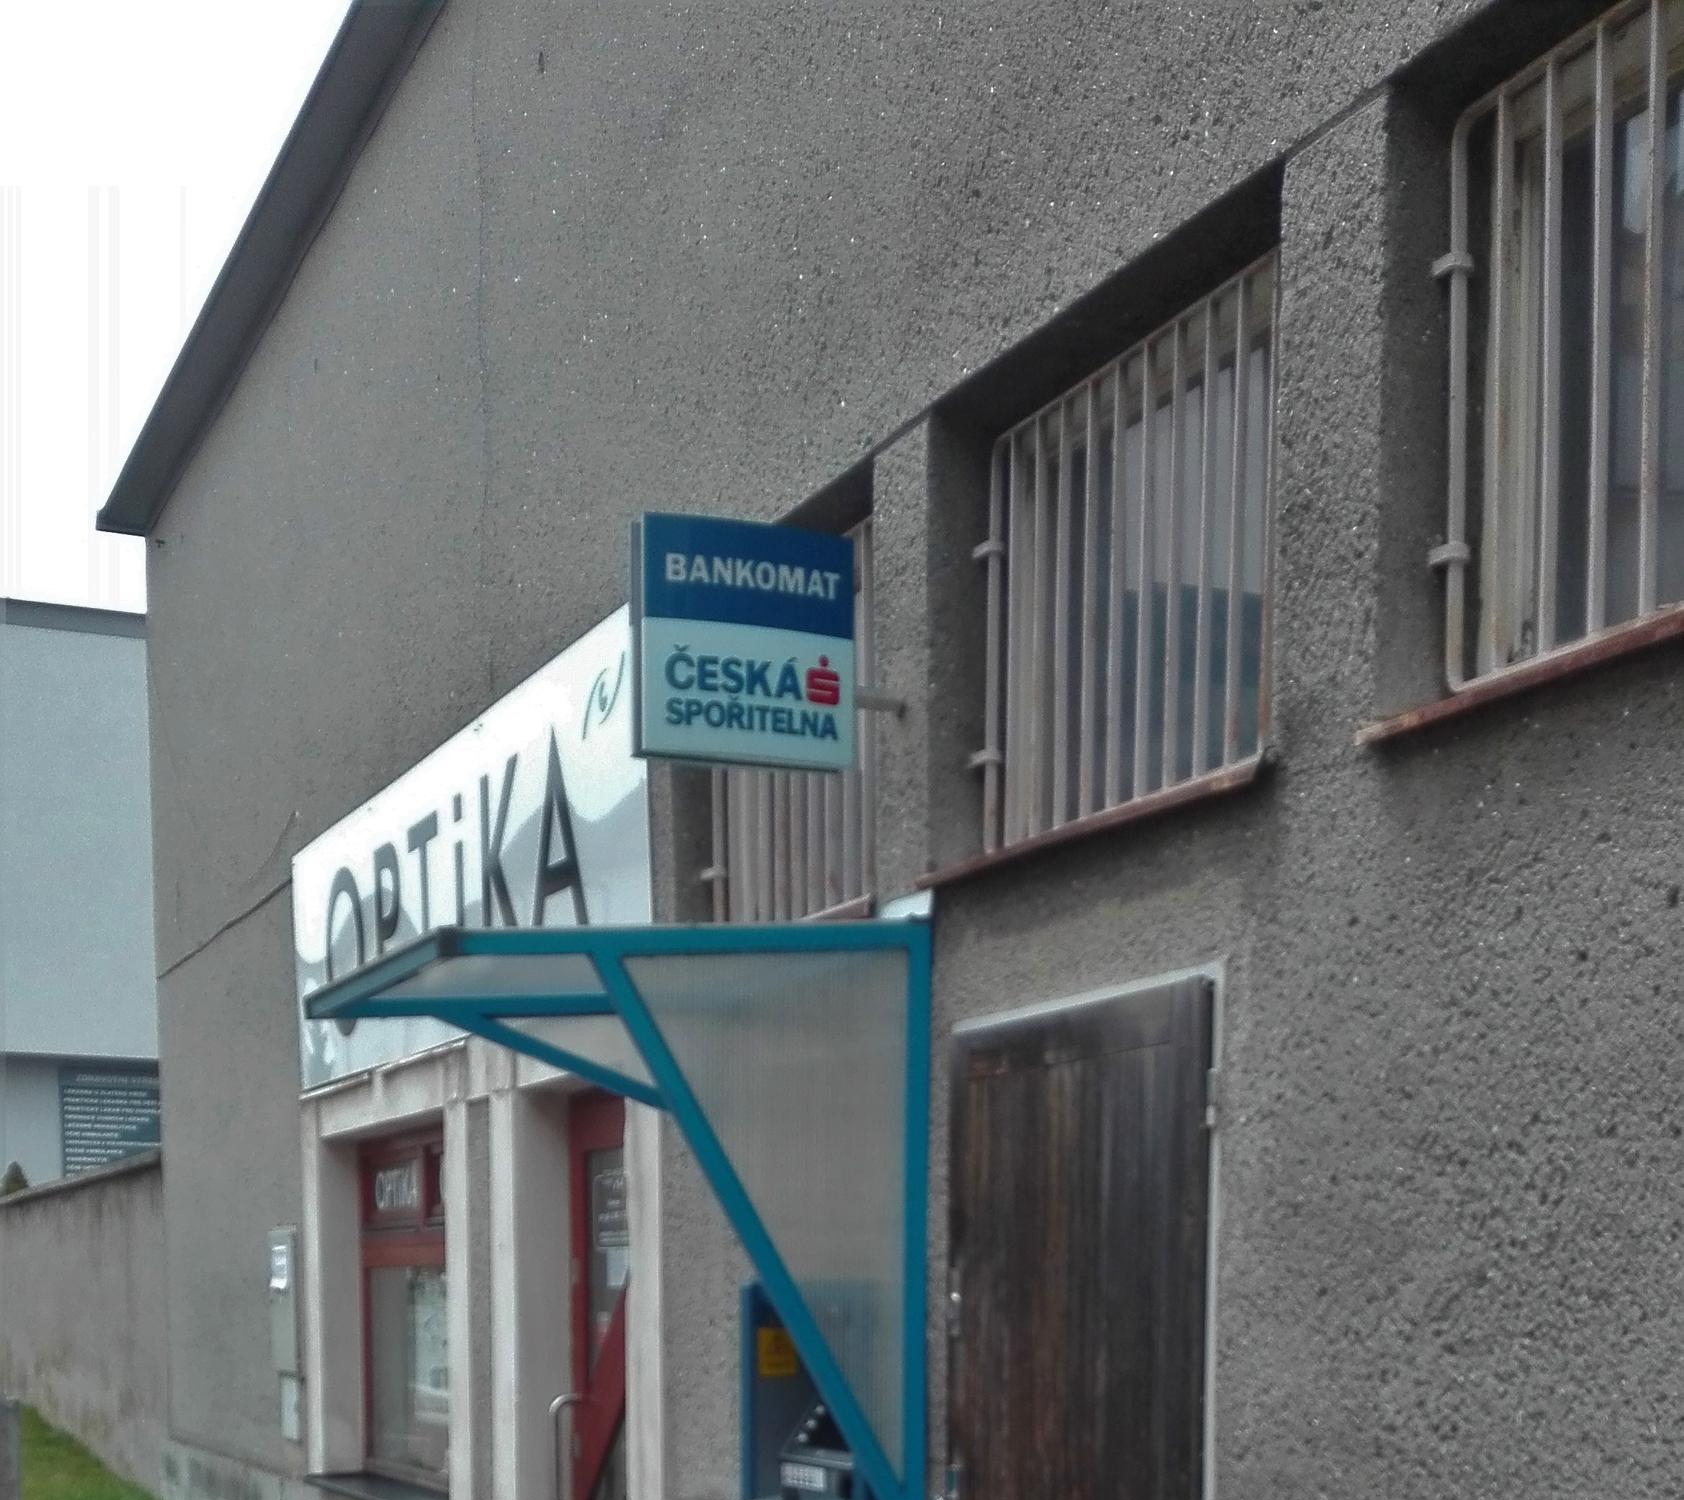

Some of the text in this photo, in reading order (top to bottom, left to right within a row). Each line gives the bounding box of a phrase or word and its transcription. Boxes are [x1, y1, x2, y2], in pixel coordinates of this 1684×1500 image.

[664, 552, 841, 600] BANKOMAT
[664, 644, 803, 701] ČESKÁ
[665, 694, 838, 741] SPOŘITELNA
